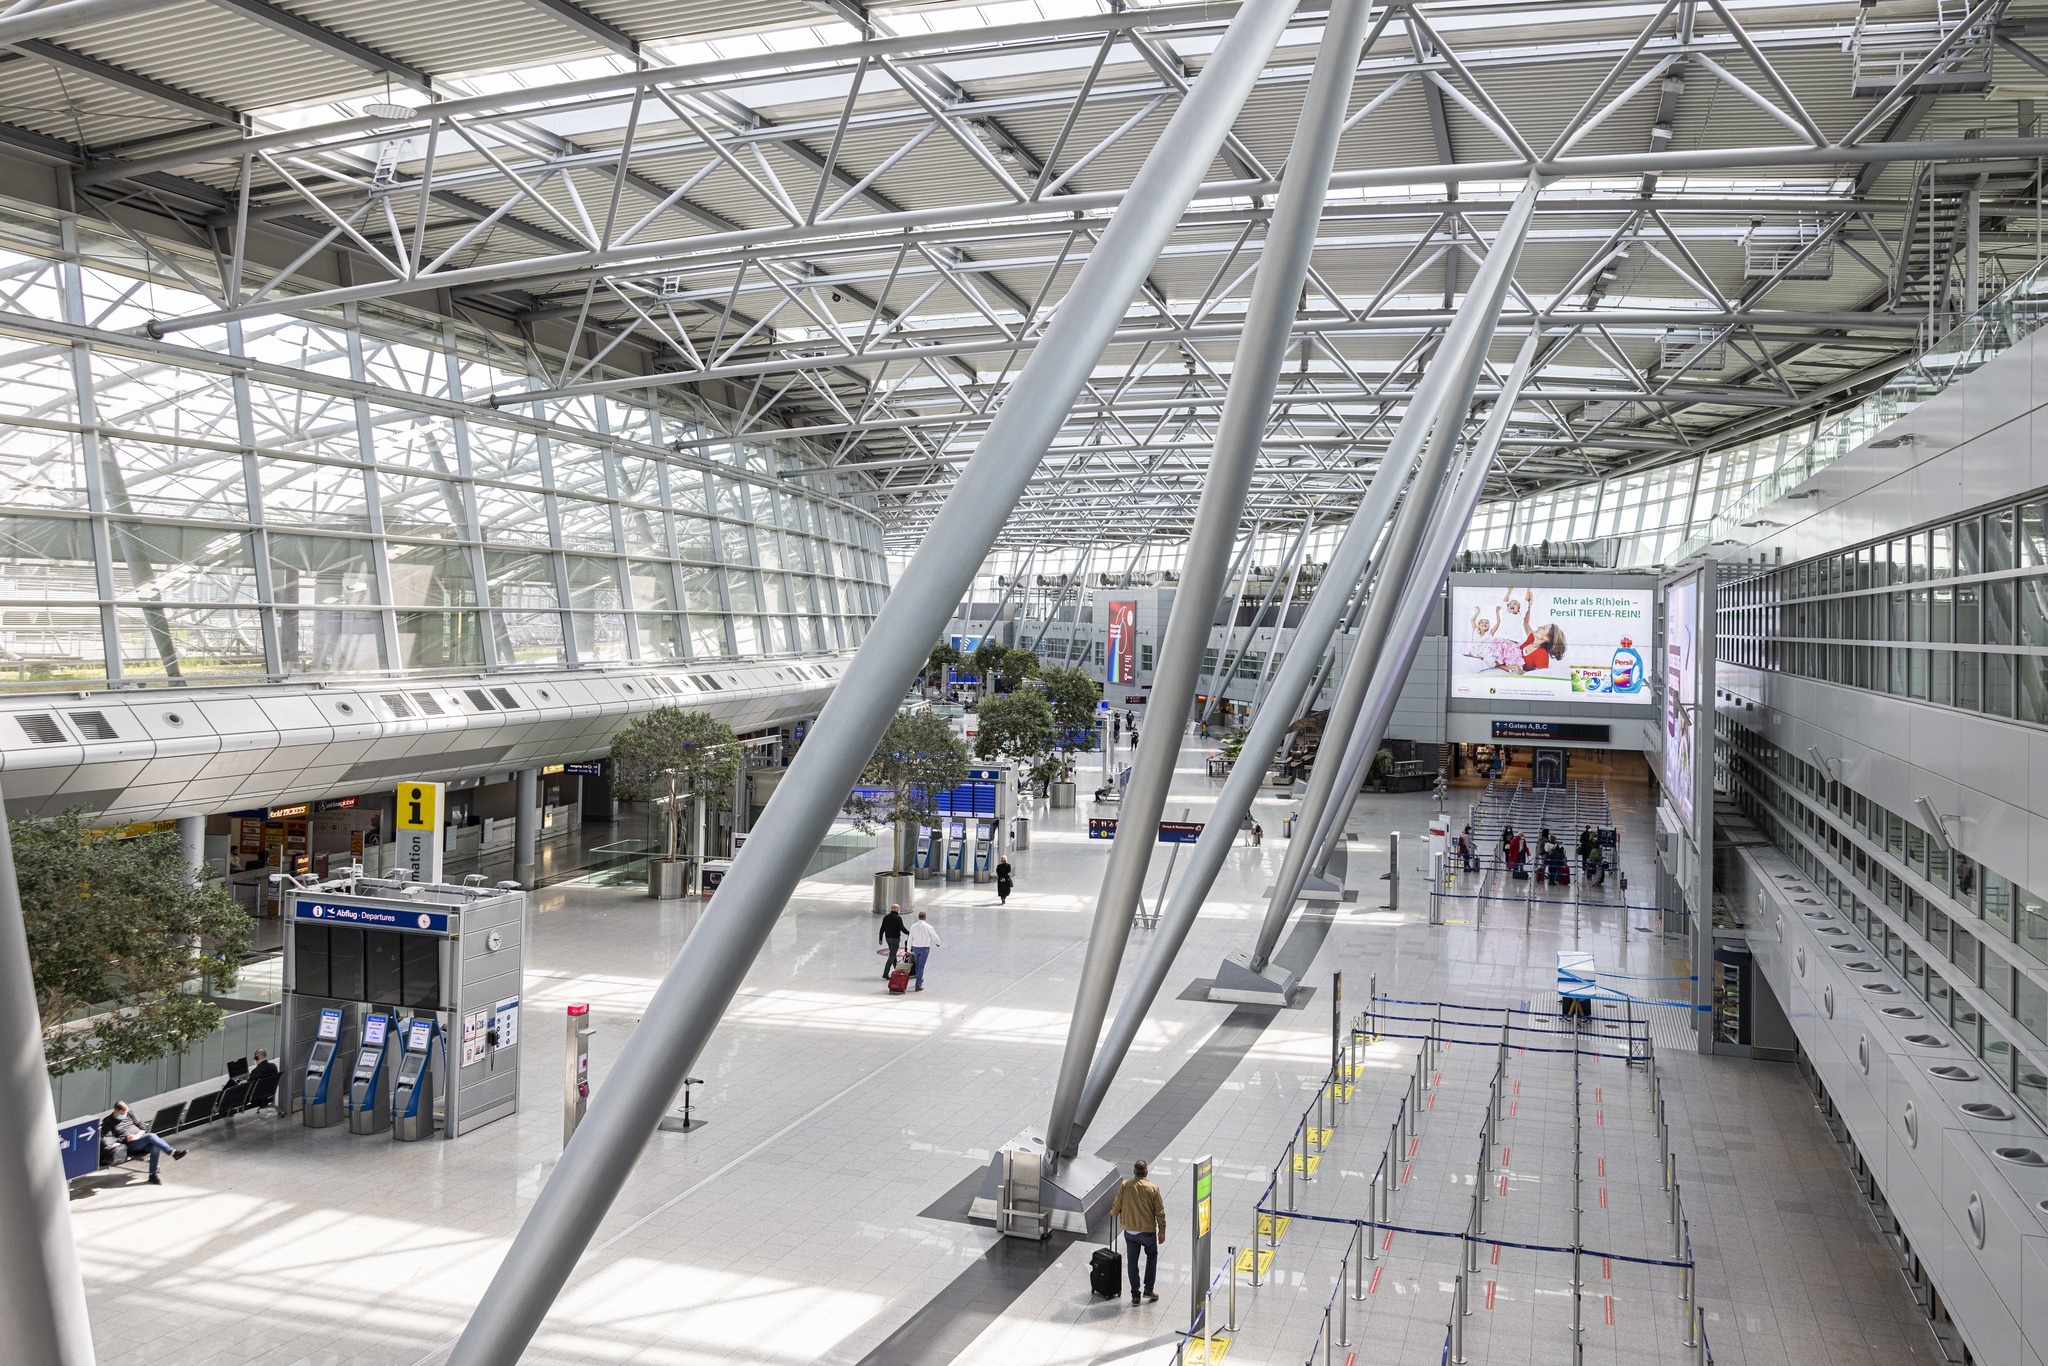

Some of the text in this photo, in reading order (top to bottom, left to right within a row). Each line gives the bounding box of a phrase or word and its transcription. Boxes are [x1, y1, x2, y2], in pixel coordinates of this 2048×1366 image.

[1553, 597, 1578, 605] Mehr
[1580, 597, 1593, 605] als
[1596, 597, 1630, 607] R(h)ein
[1550, 608, 1641, 618] Persil TIEFEN-REIN!
[282, 805, 306, 816] TICKETS
[336, 909, 396, 922] Abflug Departures
